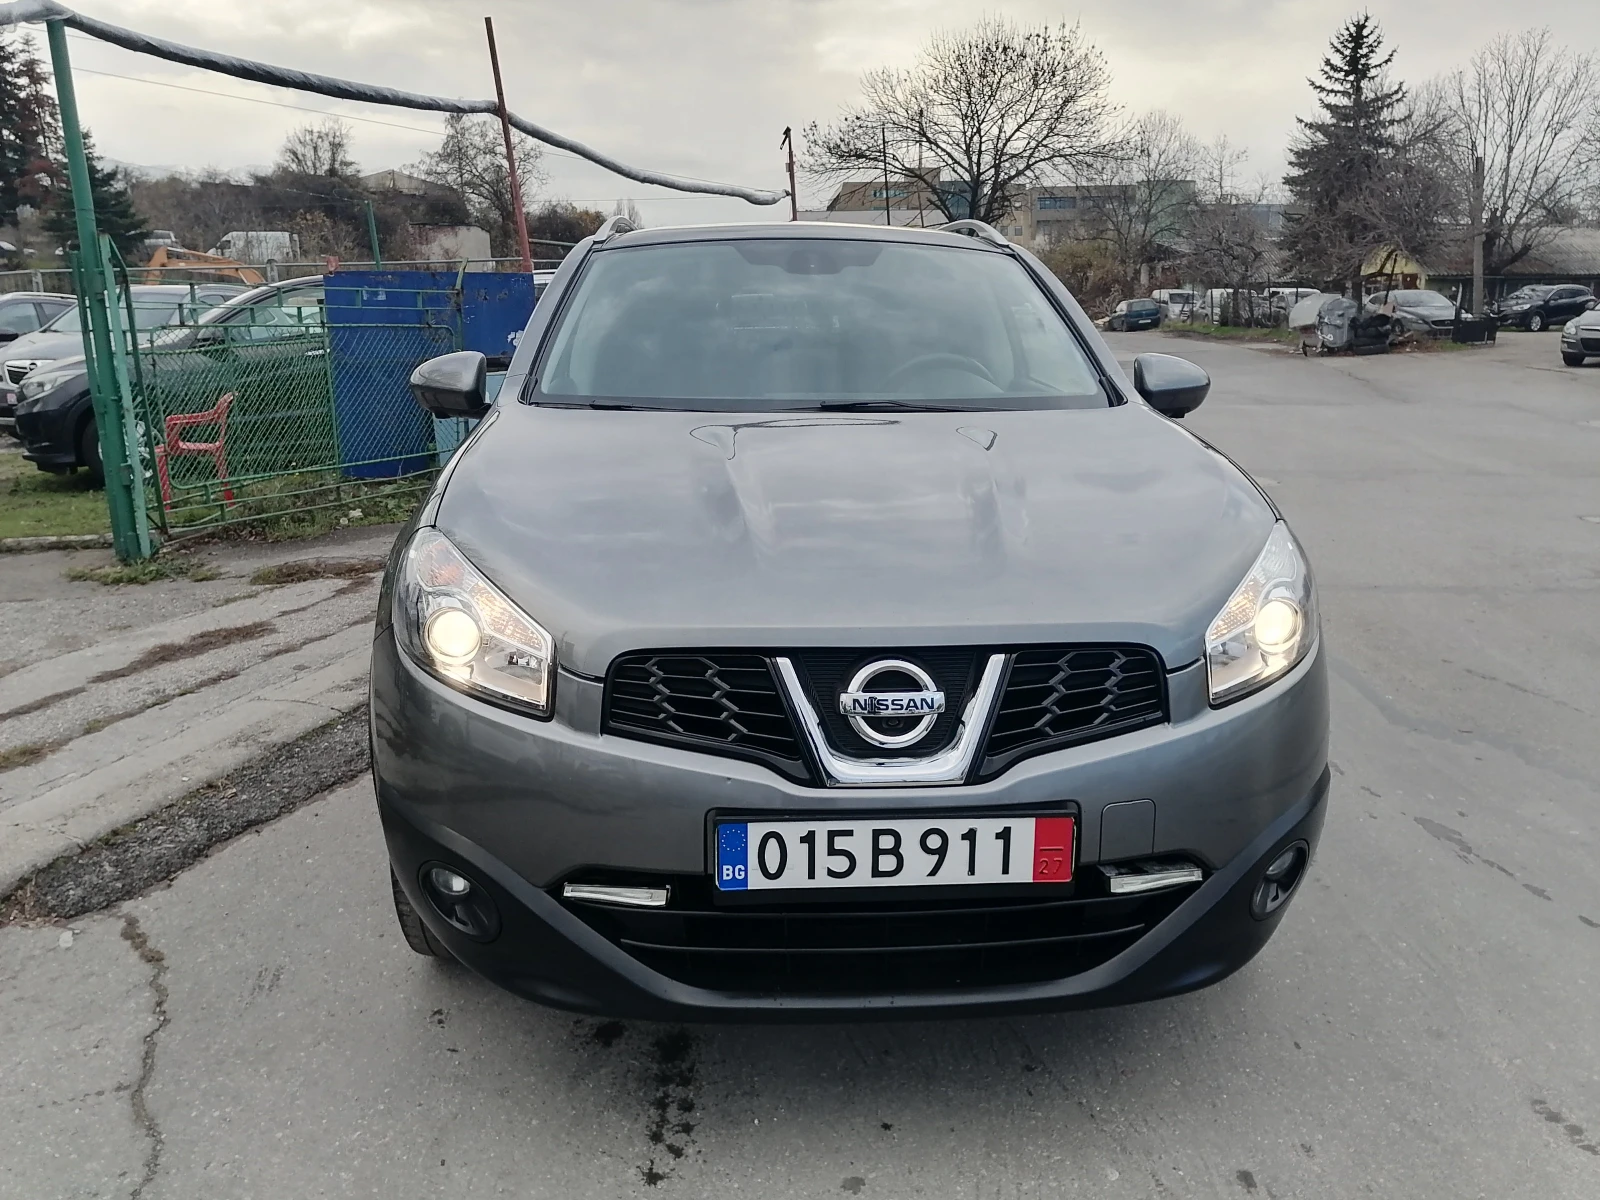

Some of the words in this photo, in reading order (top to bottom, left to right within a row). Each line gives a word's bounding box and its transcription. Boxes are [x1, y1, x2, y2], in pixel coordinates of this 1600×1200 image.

[852, 697, 934, 711] NISSAN
[723, 865, 745, 880] BG
[1039, 858, 1062, 875] 27
